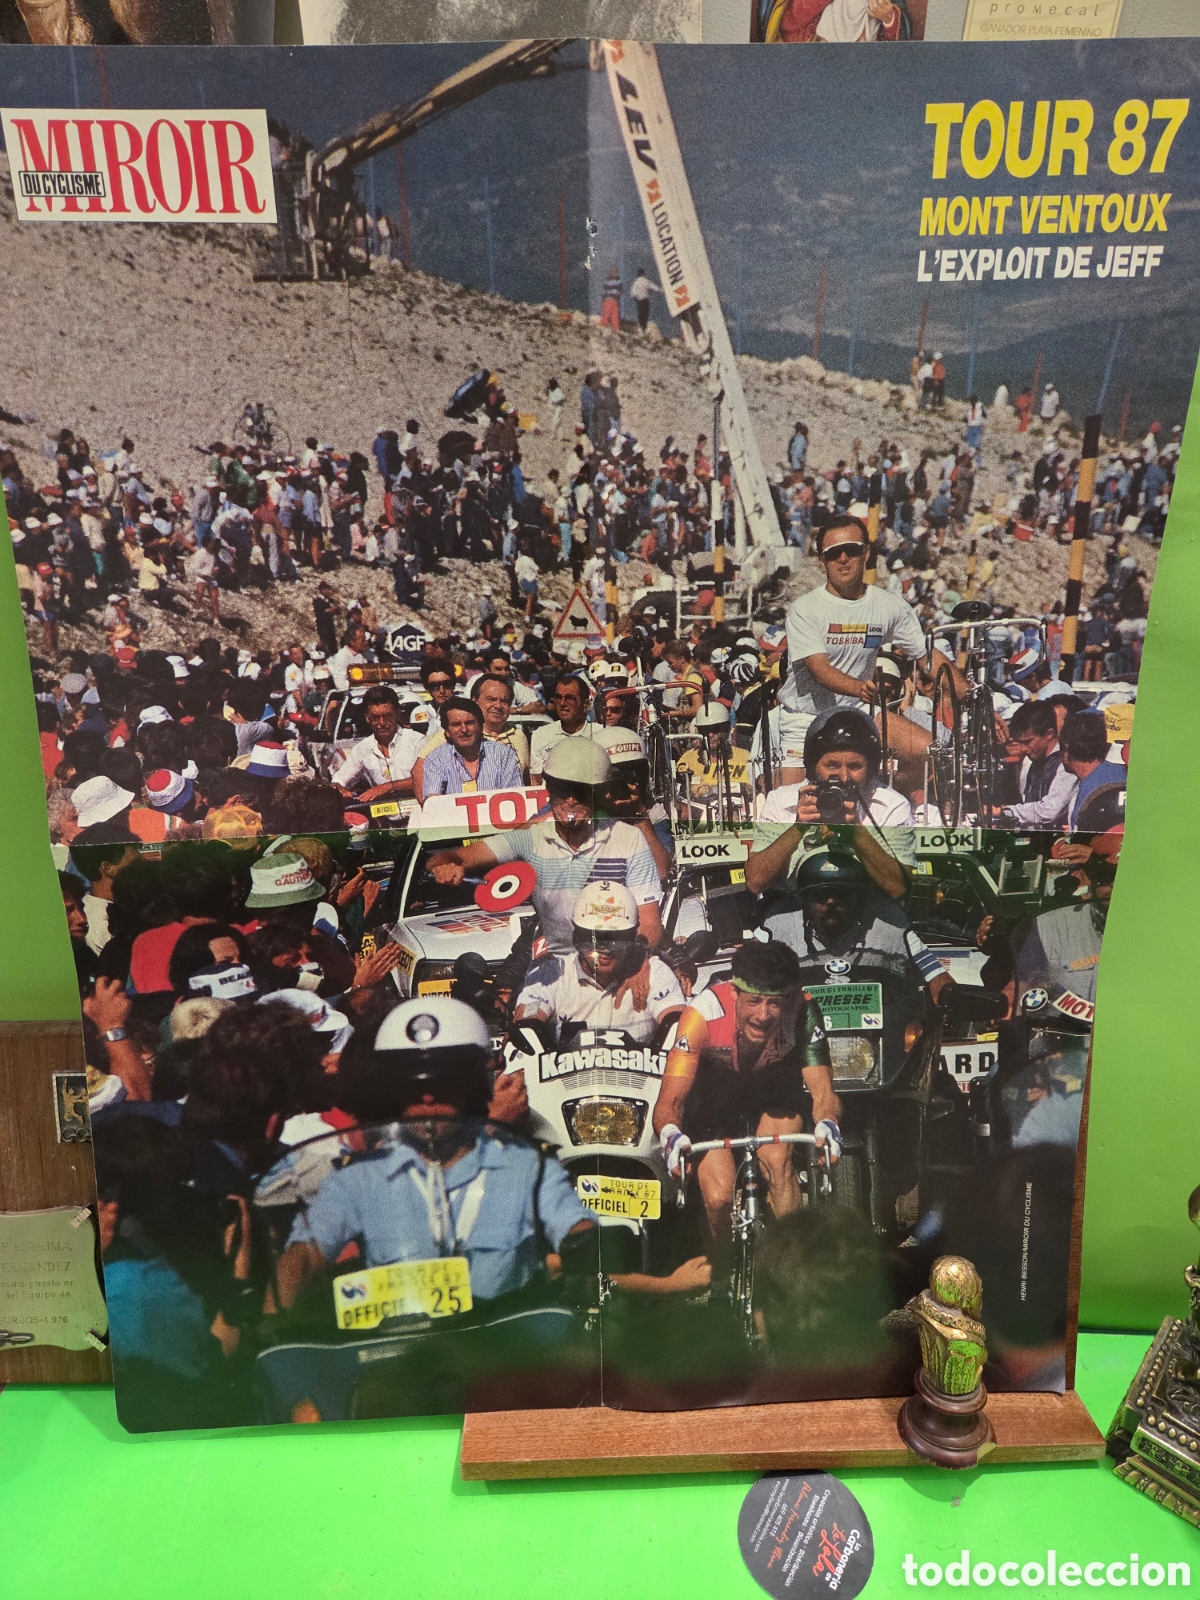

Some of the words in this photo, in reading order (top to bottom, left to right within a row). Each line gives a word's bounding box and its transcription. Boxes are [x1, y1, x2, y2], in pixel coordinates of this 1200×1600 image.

[980, 23, 1027, 34] GANADOR
[1028, 25, 1053, 35] PLATA
[1055, 27, 1102, 37] FEMENINO
[925, 99, 1094, 179] TOUR
[1107, 98, 1190, 176] 87
[10, 119, 266, 214] MIROIR
[24, 174, 41, 195] DU
[42, 174, 102, 195] CYCLISME
[919, 195, 1013, 236] MONT
[1020, 193, 1172, 234] VENTOUX
[652, 201, 684, 286] LOCATION
[917, 246, 1050, 282] L'EXPLOIT
[1054, 246, 1093, 278] DE
[1096, 245, 1164, 278] JEFF
[392, 635, 424, 651] AGF
[826, 637, 865, 645] TOSHIBA
[920, 833, 974, 848] LOOK
[681, 844, 730, 858] LOOK
[815, 994, 873, 1007] PRESSE
[541, 1048, 668, 1080] Kawasaki
[610, 1180, 635, 1190] TOUR
[637, 1181, 649, 1190] DE
[1024, 1181, 1032, 1216] CYCLISME
[581, 1198, 628, 1213] OFFICIEL
[640, 1200, 649, 1218] 2
[1023, 1216, 1031, 1227] DU
[14, 1240, 72, 1252] ESGRIMA
[29, 1279, 61, 1289] puesto
[4, 1290, 19, 1299] del
[59, 1289, 71, 1298] de
[431, 1286, 461, 1314] 25
